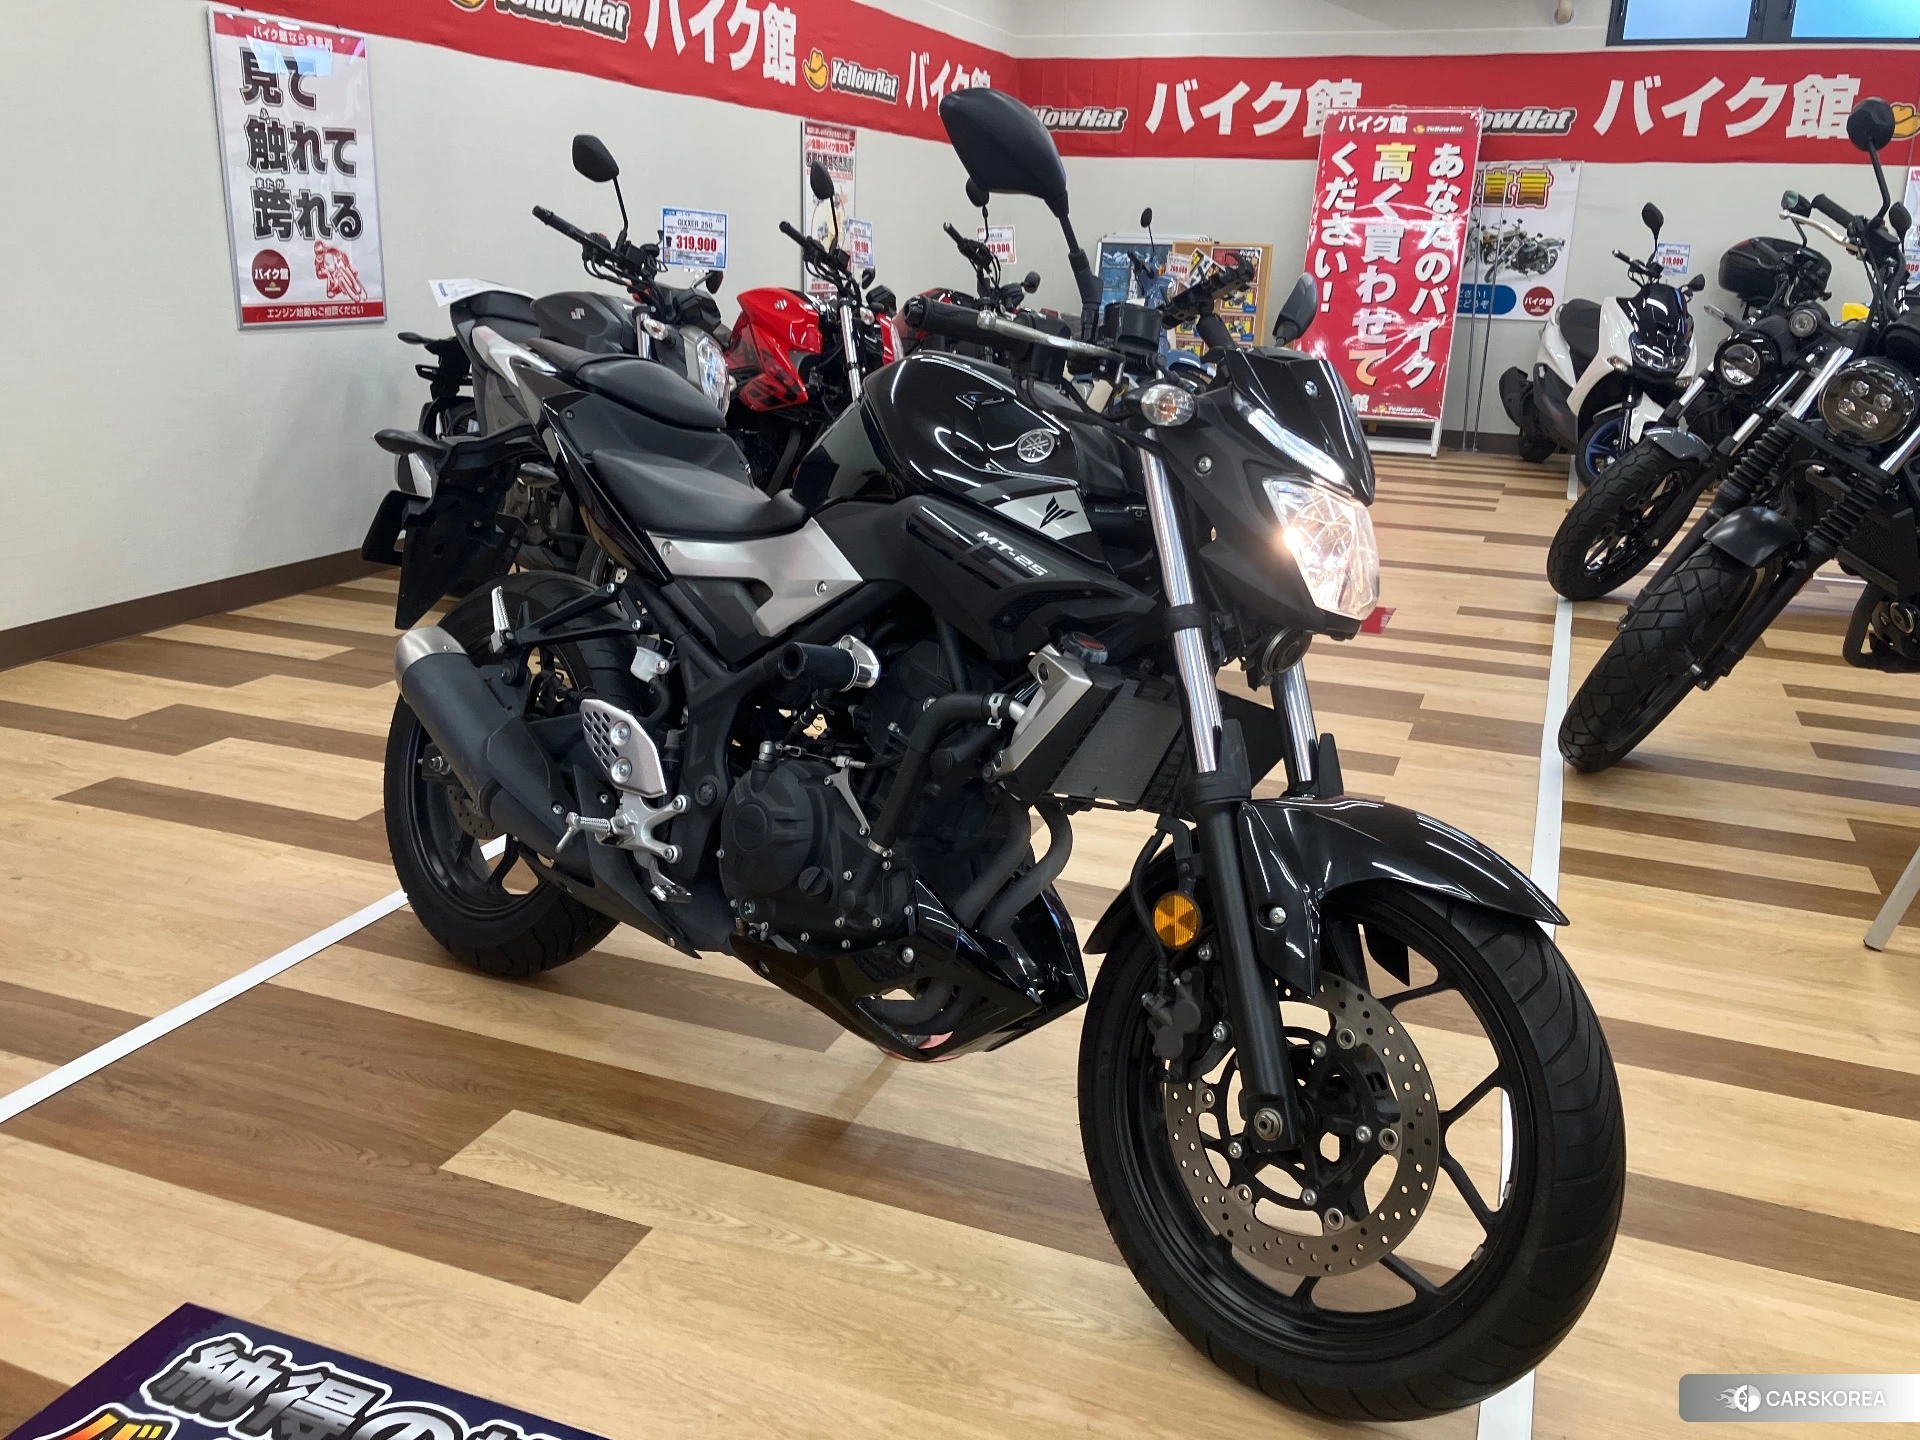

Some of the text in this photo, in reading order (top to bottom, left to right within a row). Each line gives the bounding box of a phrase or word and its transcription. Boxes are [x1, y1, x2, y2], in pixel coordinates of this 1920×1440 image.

[831, 60, 898, 98] YellowHat
[1593, 74, 1861, 139] バイク館
[1144, 78, 1362, 138] バイク館
[1338, 115, 1408, 134] バイク館
[1426, 124, 1463, 133] YellowHat
[244, 114, 357, 178] 触れて
[250, 185, 364, 242] 跨れる
[1314, 141, 1359, 313] ください!
[676, 234, 717, 252] 319,900
[1348, 142, 1417, 387] 高く買わせて
[976, 530, 1049, 577] MT-25
